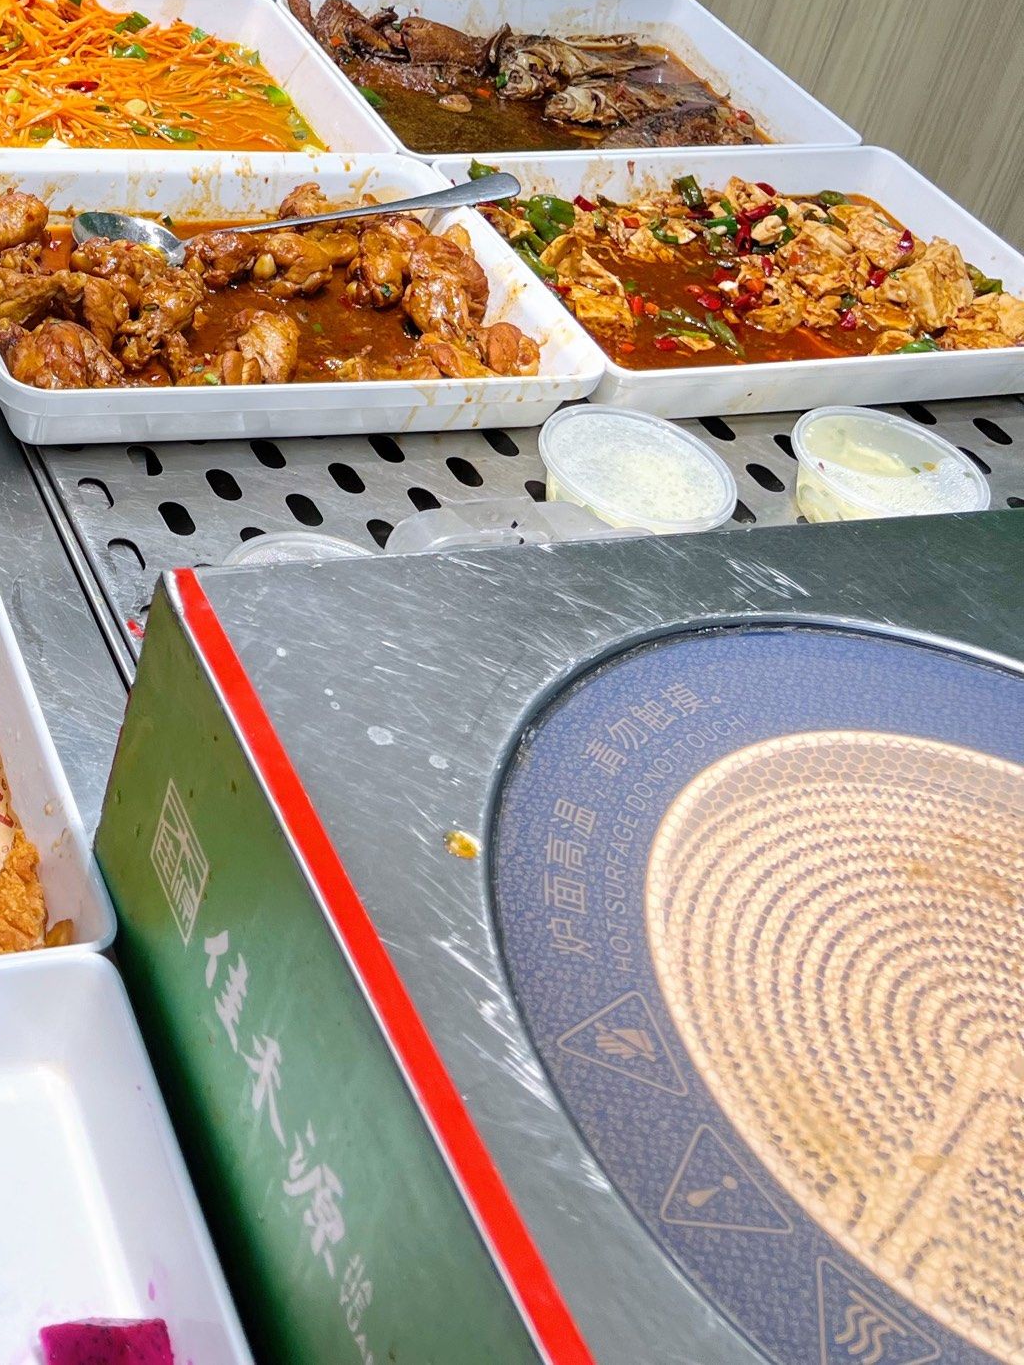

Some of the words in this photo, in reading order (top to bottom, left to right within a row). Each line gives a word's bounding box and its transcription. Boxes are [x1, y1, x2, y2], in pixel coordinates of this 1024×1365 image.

[606, 918, 637, 973] HOT
[625, 782, 653, 811] DO
[643, 748, 681, 785] NOT
[204, 930, 345, 1279] 佳禾源
